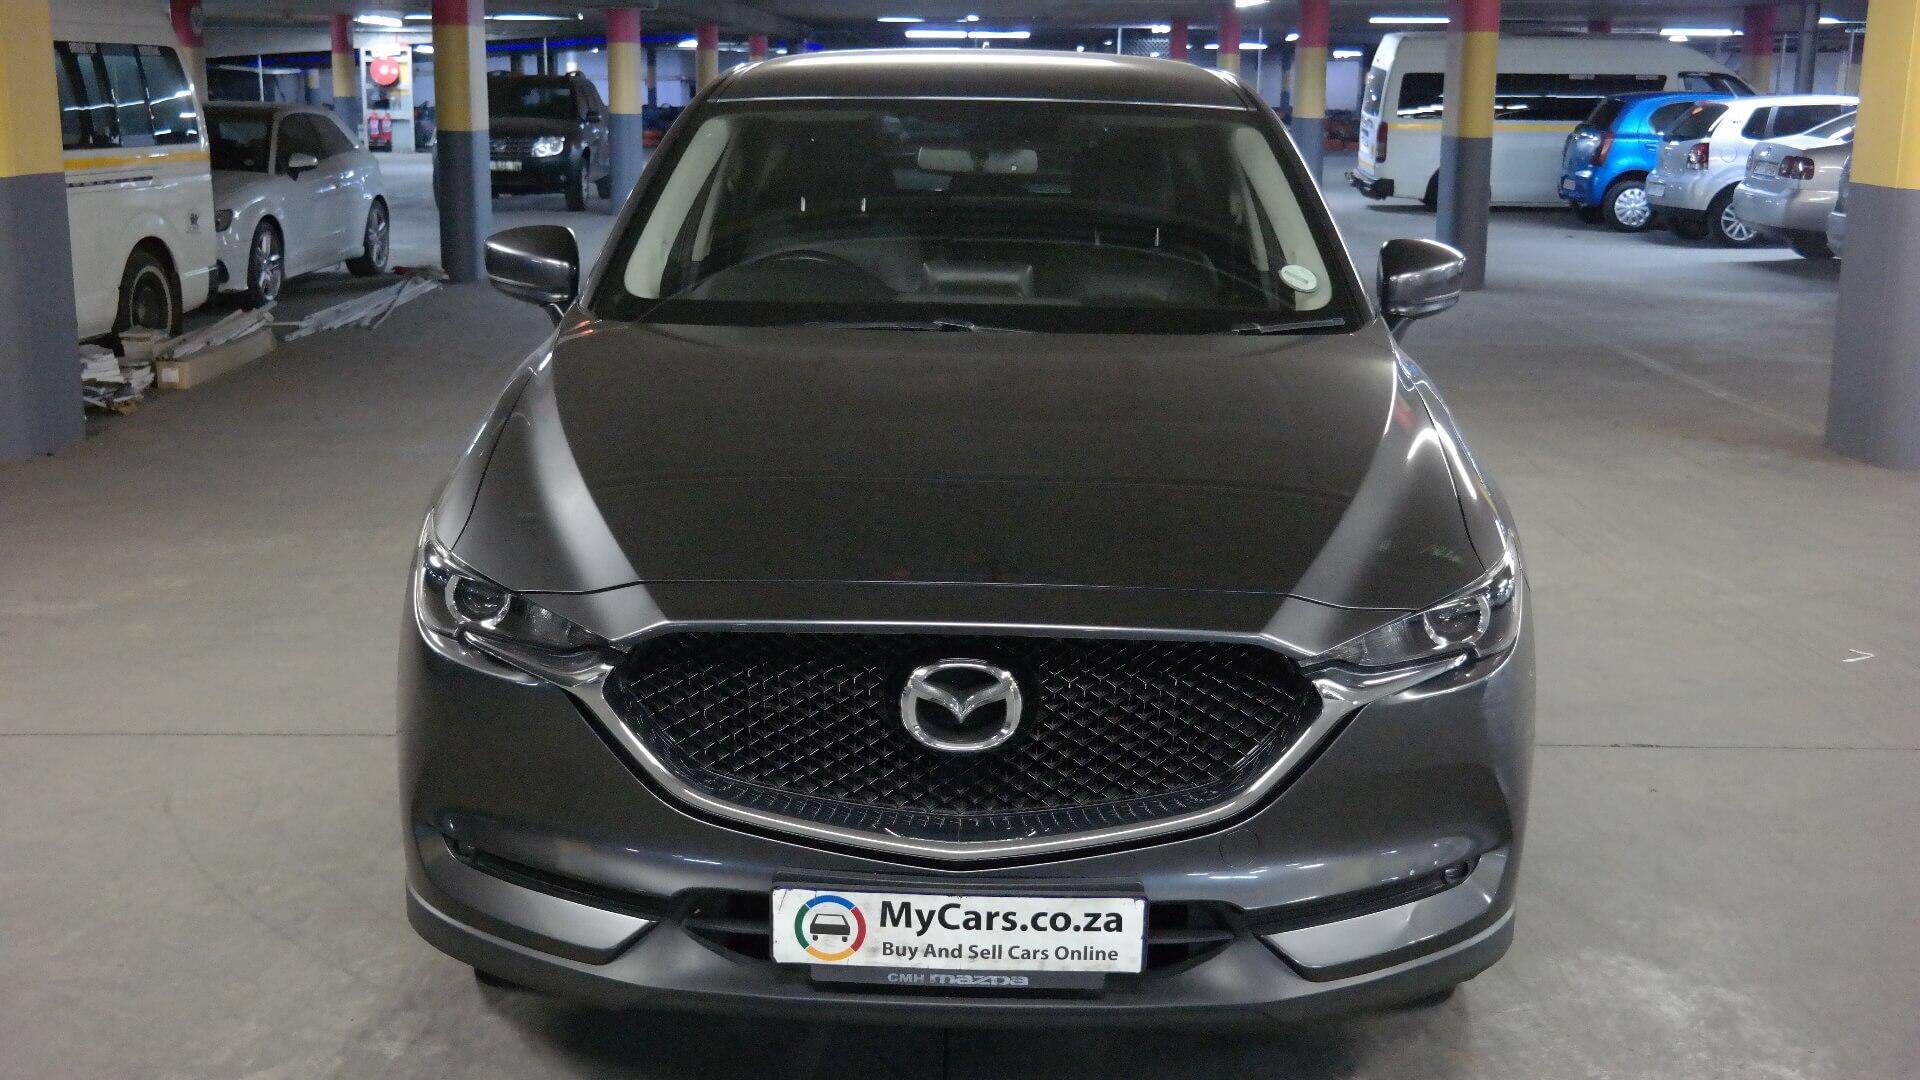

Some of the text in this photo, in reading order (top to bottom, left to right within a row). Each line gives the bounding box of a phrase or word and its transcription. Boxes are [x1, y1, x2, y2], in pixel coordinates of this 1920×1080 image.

[880, 900, 1123, 937] MyCars.co.za
[882, 941, 1119, 961] Buy And Sell Cars Online
[887, 972, 925, 984] CMH
